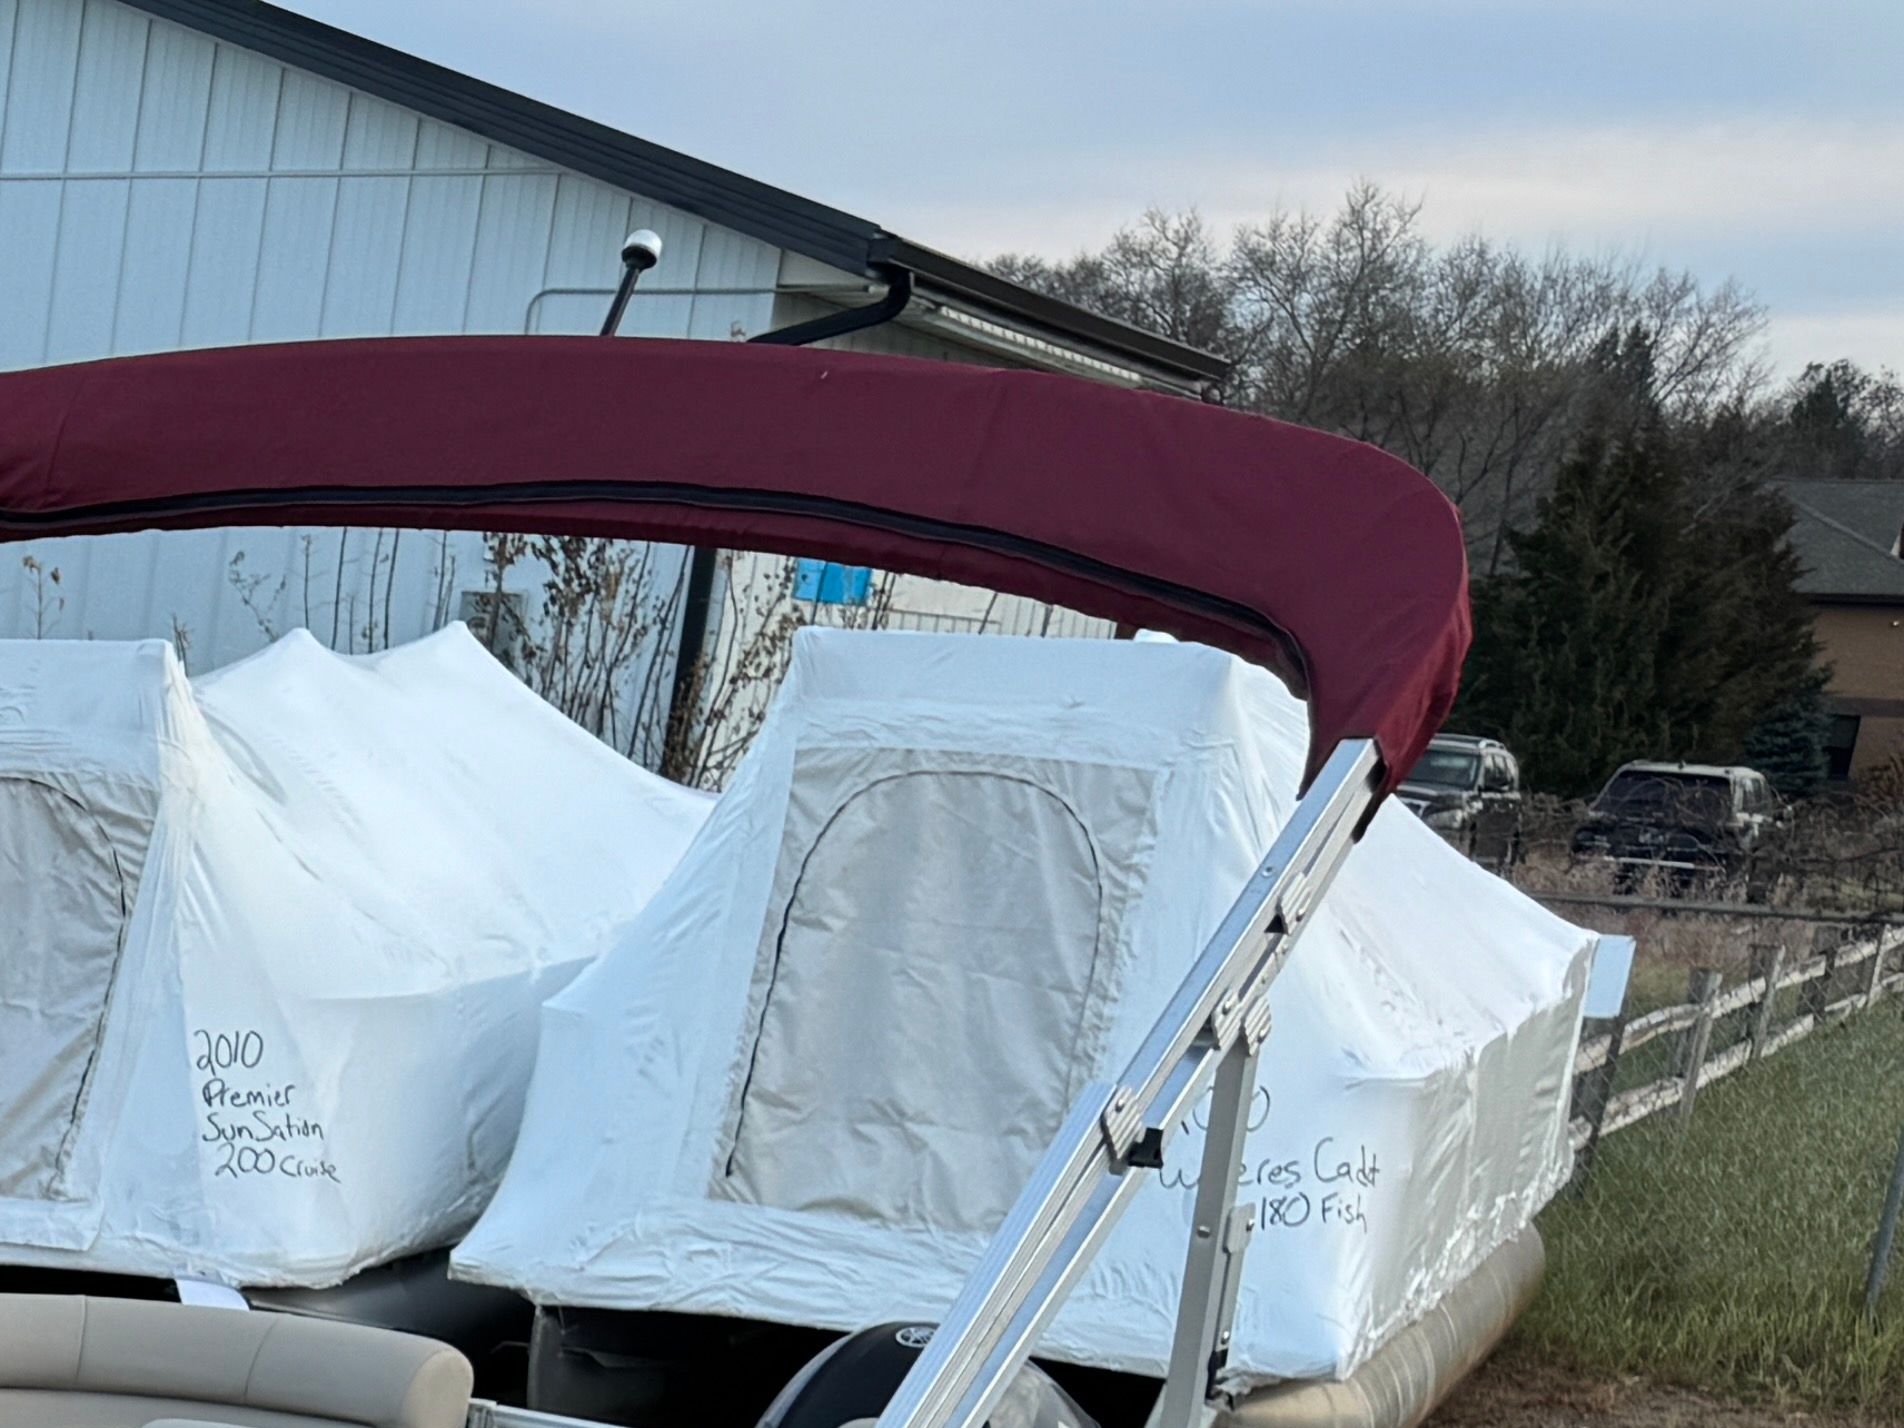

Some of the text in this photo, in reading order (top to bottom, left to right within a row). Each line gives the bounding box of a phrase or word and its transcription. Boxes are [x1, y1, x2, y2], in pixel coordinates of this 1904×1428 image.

[193, 1029, 264, 1076] 2010
[202, 1078, 296, 1107] Premier
[214, 1142, 276, 1179] 200
[1261, 1192, 1368, 1234] 180 Fish
